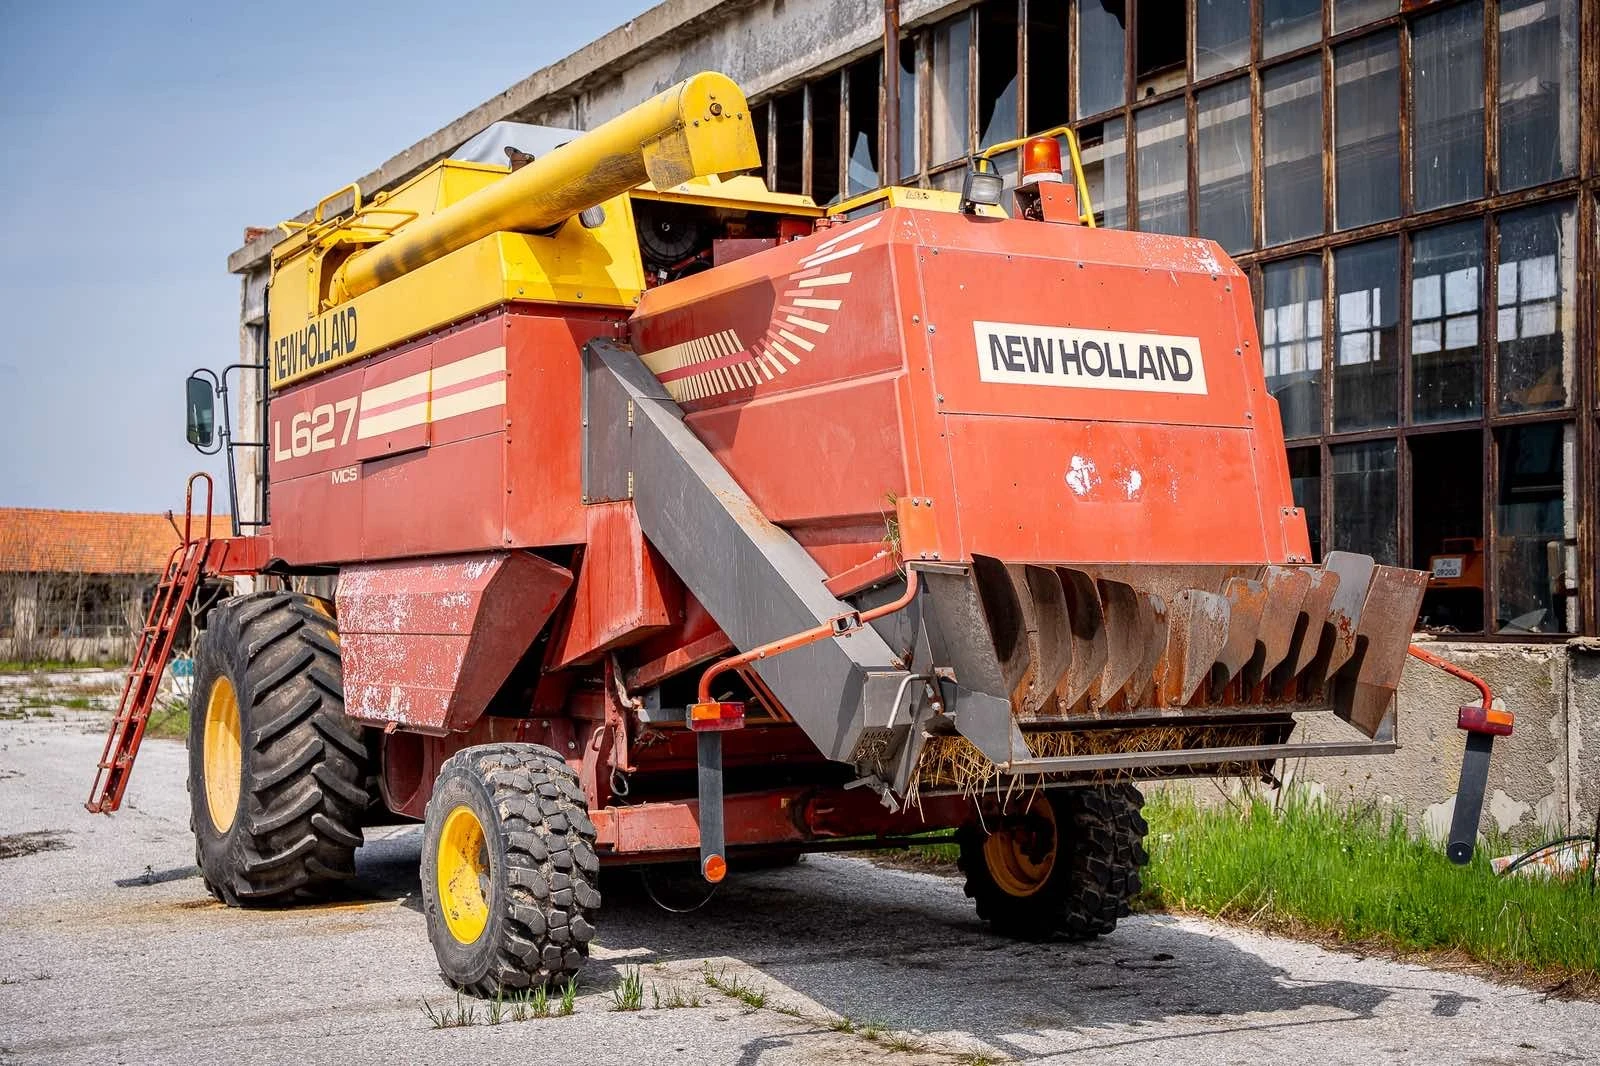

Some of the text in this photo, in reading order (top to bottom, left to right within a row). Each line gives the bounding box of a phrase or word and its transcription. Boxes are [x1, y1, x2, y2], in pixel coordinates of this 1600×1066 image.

[274, 306, 358, 382] NEW HOLLAND
[988, 333, 1193, 382] NEW HOLLAND
[274, 396, 358, 463] L627
[331, 467, 357, 485] MCS
